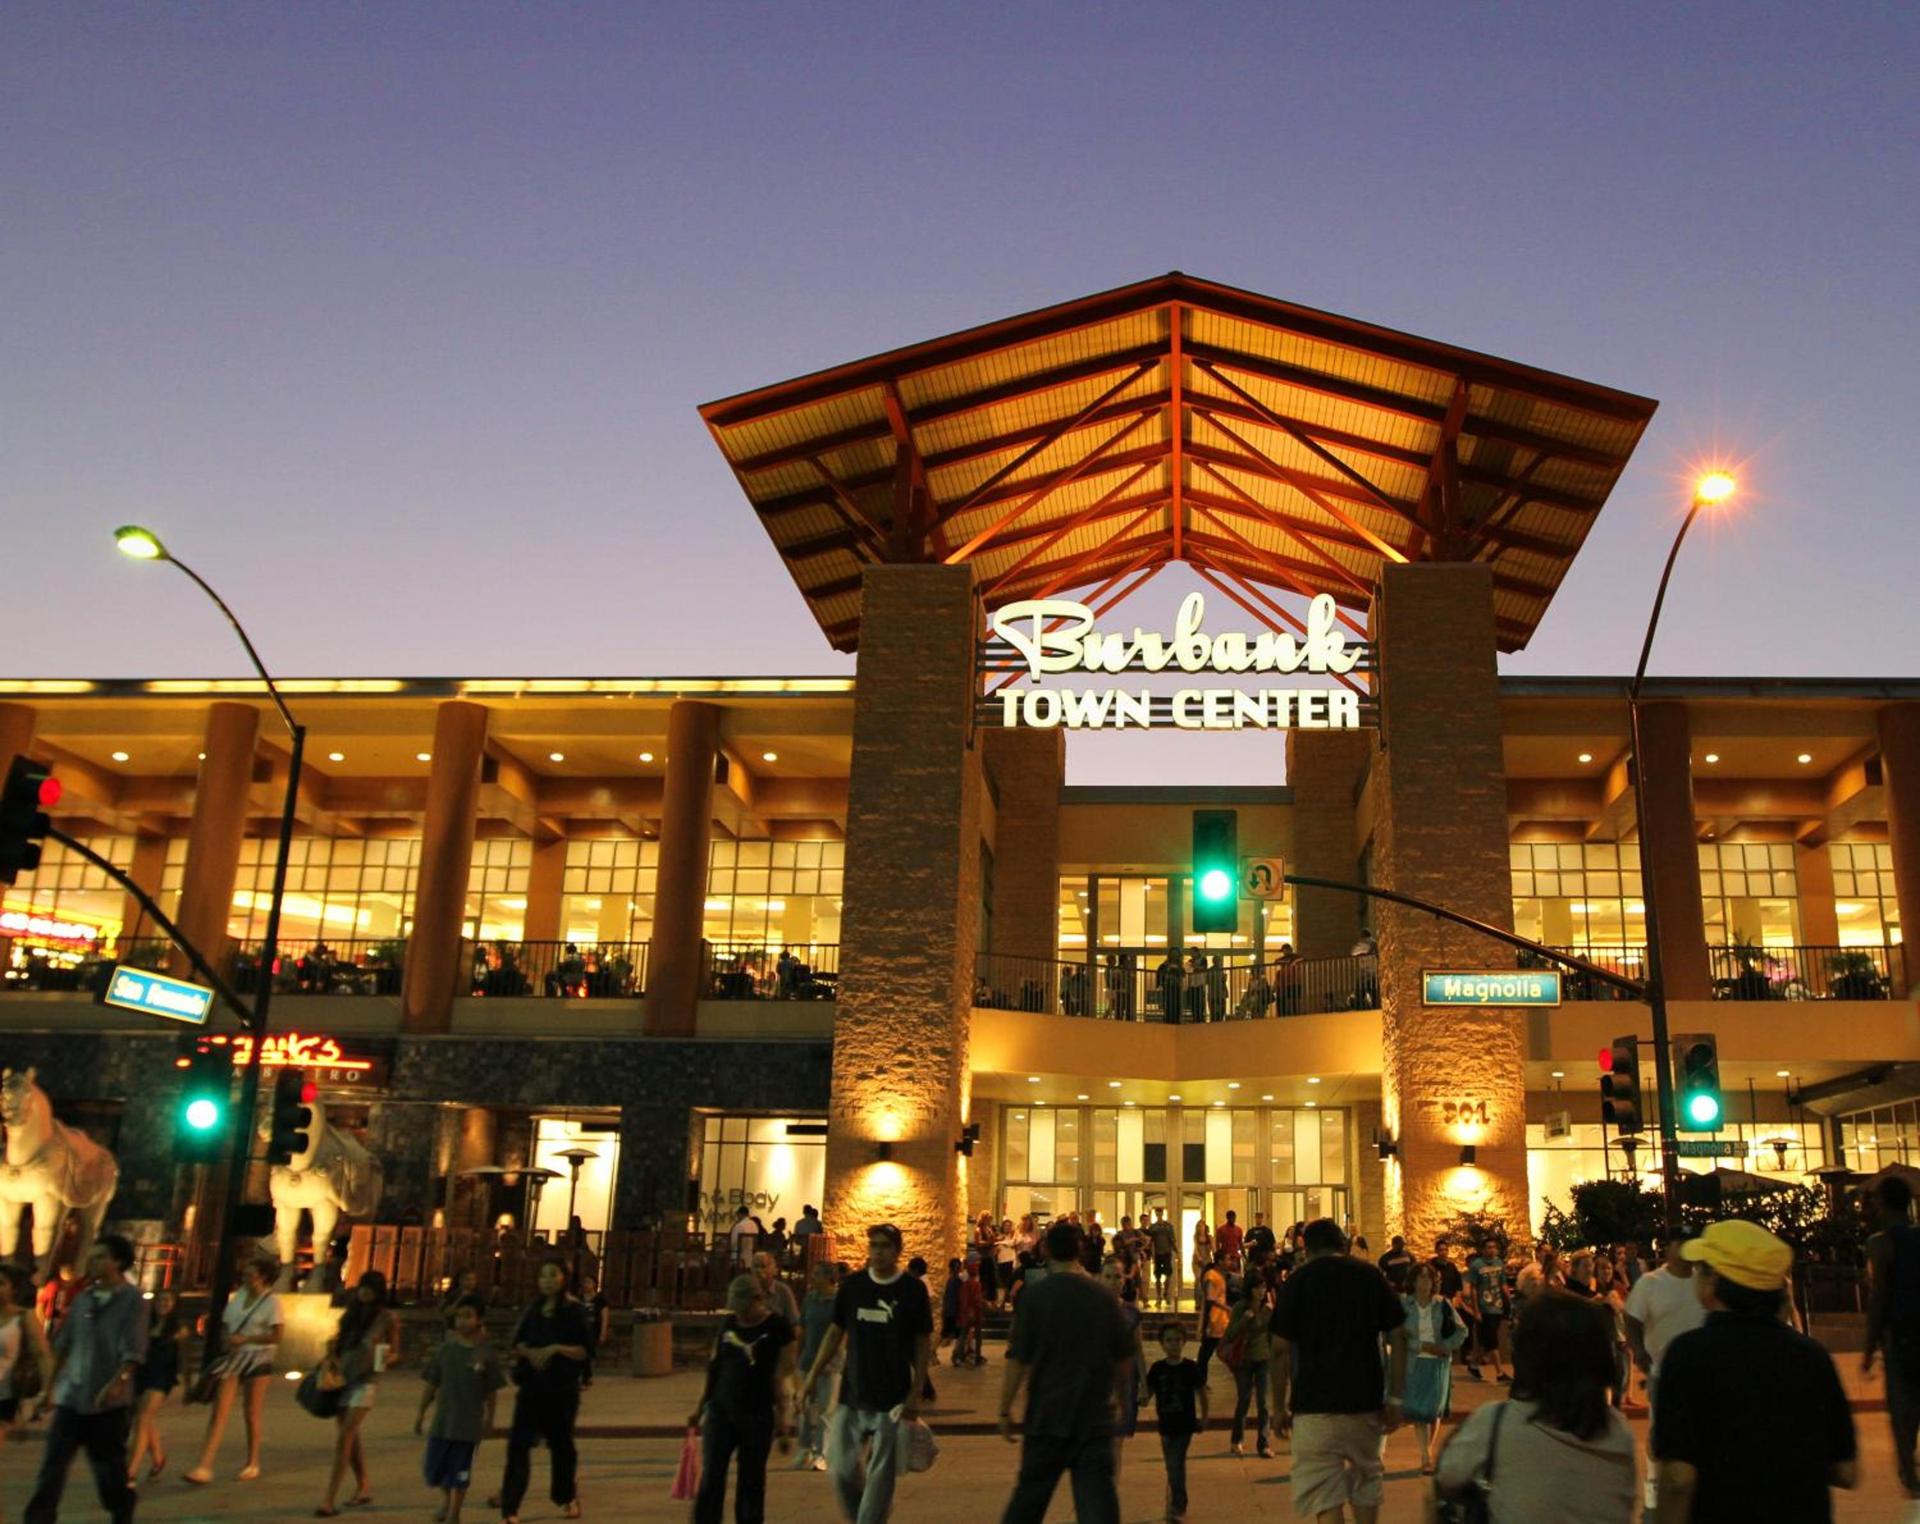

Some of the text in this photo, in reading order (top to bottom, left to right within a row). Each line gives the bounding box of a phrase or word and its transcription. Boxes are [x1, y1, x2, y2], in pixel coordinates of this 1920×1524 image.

[992, 592, 1362, 683] Burbank
[996, 688, 1361, 729] TOWN CENTER
[1443, 977, 1542, 1002] Magnolia
[729, 1187, 779, 1213] Body
